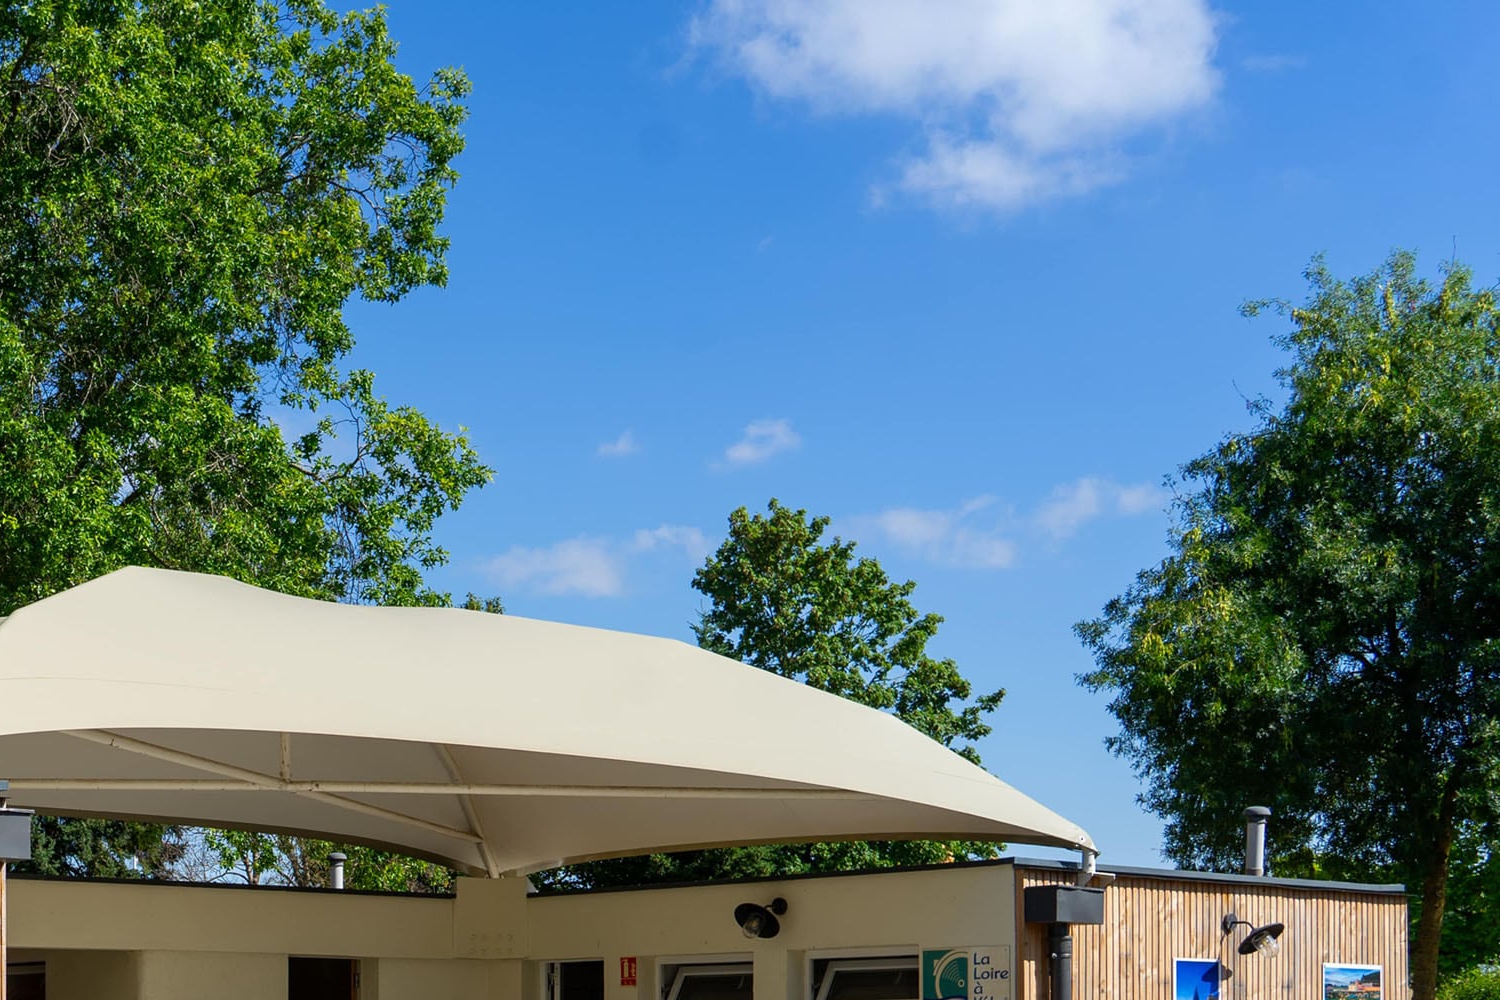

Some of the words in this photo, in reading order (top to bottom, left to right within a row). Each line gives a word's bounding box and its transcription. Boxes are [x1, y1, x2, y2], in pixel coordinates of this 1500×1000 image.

[973, 953, 990, 965] La
[973, 968, 1009, 980] Loire
[973, 983, 983, 994] à
